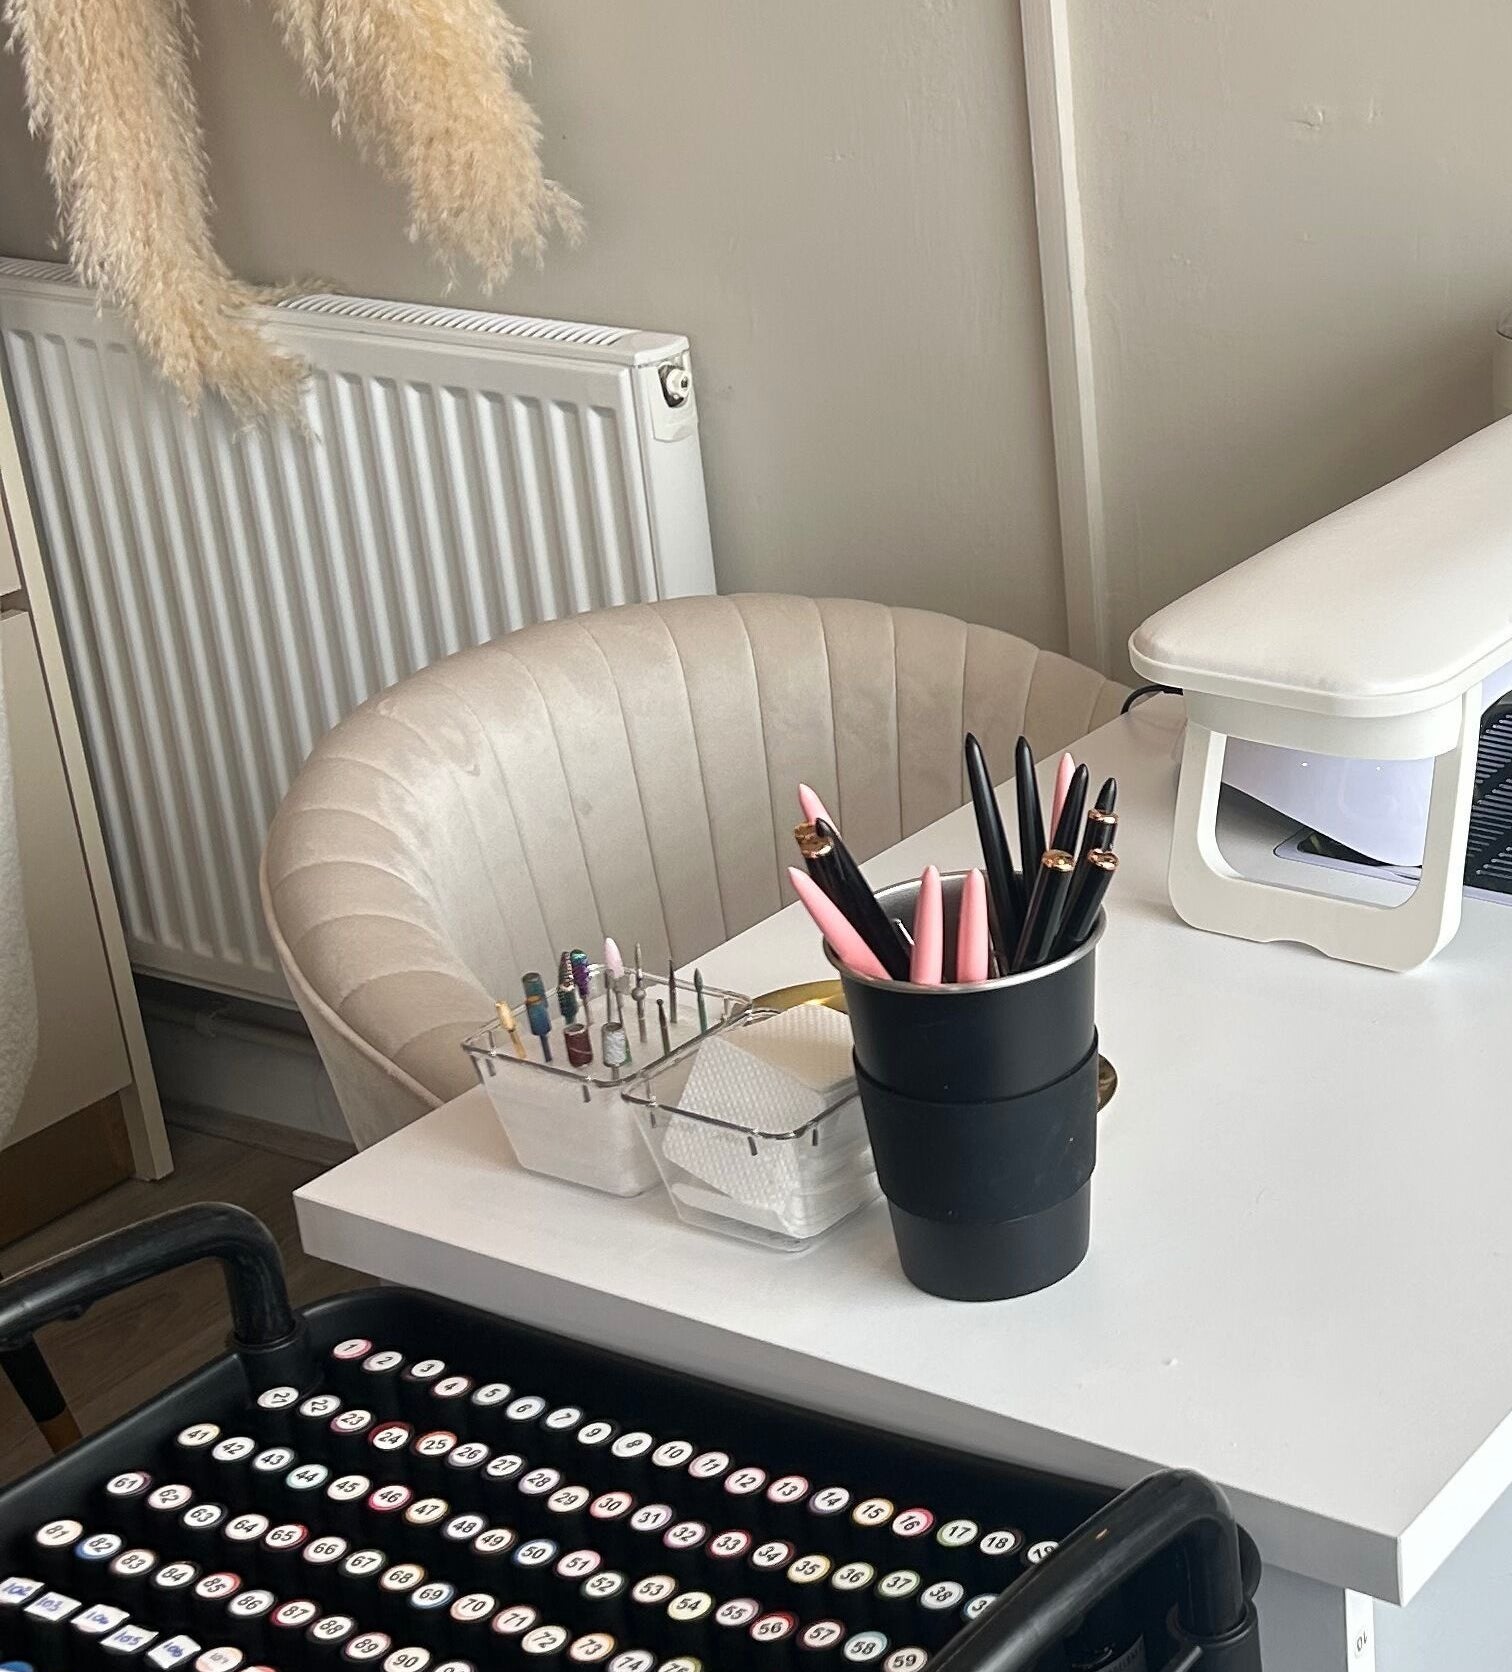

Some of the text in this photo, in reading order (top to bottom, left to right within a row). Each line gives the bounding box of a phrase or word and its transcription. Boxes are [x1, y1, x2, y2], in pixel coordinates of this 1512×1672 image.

[421, 1364, 434, 1372] 3
[272, 1393, 290, 1403] 21
[485, 1389, 500, 1397] 5
[312, 1400, 328, 1412] 22
[517, 1404, 532, 1412] 6
[341, 1414, 364, 1425] 23
[188, 1430, 209, 1440] 41
[378, 1432, 402, 1444] 24
[586, 1428, 601, 1437] 9
[223, 1443, 244, 1454] 42
[424, 1440, 445, 1450] 25
[626, 1440, 642, 1448] 8
[457, 1447, 481, 1459] 26
[664, 1446, 684, 1458] 10
[261, 1454, 284, 1465] 43
[492, 1459, 517, 1470] 27
[703, 1459, 720, 1471] 11
[296, 1471, 318, 1482] 44
[527, 1473, 551, 1487] 28
[735, 1474, 756, 1488] 12
[115, 1478, 137, 1488] 61
[336, 1481, 359, 1492] 45
[777, 1482, 798, 1496] 13
[160, 1489, 178, 1503] 62
[379, 1491, 402, 1502] 46
[554, 1493, 578, 1505] 29
[822, 1493, 842, 1506] 14
[415, 1505, 439, 1515] 47
[599, 1498, 622, 1511] 30
[191, 1509, 213, 1522] 63
[639, 1512, 661, 1523] 31
[863, 1505, 884, 1518] 15
[234, 1520, 258, 1532] 64
[453, 1521, 476, 1533] 48
[900, 1516, 920, 1530] 16
[47, 1526, 67, 1538] 81
[271, 1530, 295, 1541] 65
[674, 1528, 696, 1541] 32
[949, 1526, 971, 1538] 17
[90, 1538, 112, 1552] 82
[482, 1535, 504, 1546] 49
[717, 1537, 740, 1550] 33
[987, 1537, 1008, 1549] 18
[314, 1543, 337, 1554] 66
[522, 1547, 545, 1559] 50
[759, 1547, 781, 1562] 34
[122, 1555, 145, 1569] 83
[351, 1556, 376, 1567] 67
[567, 1558, 589, 1570] 51
[796, 1561, 820, 1575] 35
[162, 1568, 186, 1581] 84
[390, 1571, 413, 1583] 68
[840, 1569, 864, 1583] 36
[204, 1578, 225, 1592] 85
[591, 1577, 614, 1592] 52
[640, 1583, 664, 1595] 53
[887, 1577, 912, 1589] 37
[419, 1589, 443, 1600] 69
[930, 1587, 952, 1602] 38
[238, 1596, 262, 1609] 86
[462, 1599, 486, 1611] 70
[677, 1599, 701, 1610] 54
[972, 1601, 987, 1611] 3
[283, 1606, 308, 1618] 87
[721, 1606, 746, 1619] 55
[504, 1613, 527, 1626] 71
[320, 1620, 343, 1634] 88
[759, 1622, 782, 1634] 56
[538, 1631, 558, 1648] 72
[810, 1627, 835, 1640] 57
[355, 1639, 378, 1653] 89
[580, 1639, 602, 1655] 73
[851, 1642, 876, 1655] 58
[393, 1655, 418, 1667] 90
[618, 1657, 643, 1670] 74
[893, 1654, 917, 1668] 59
